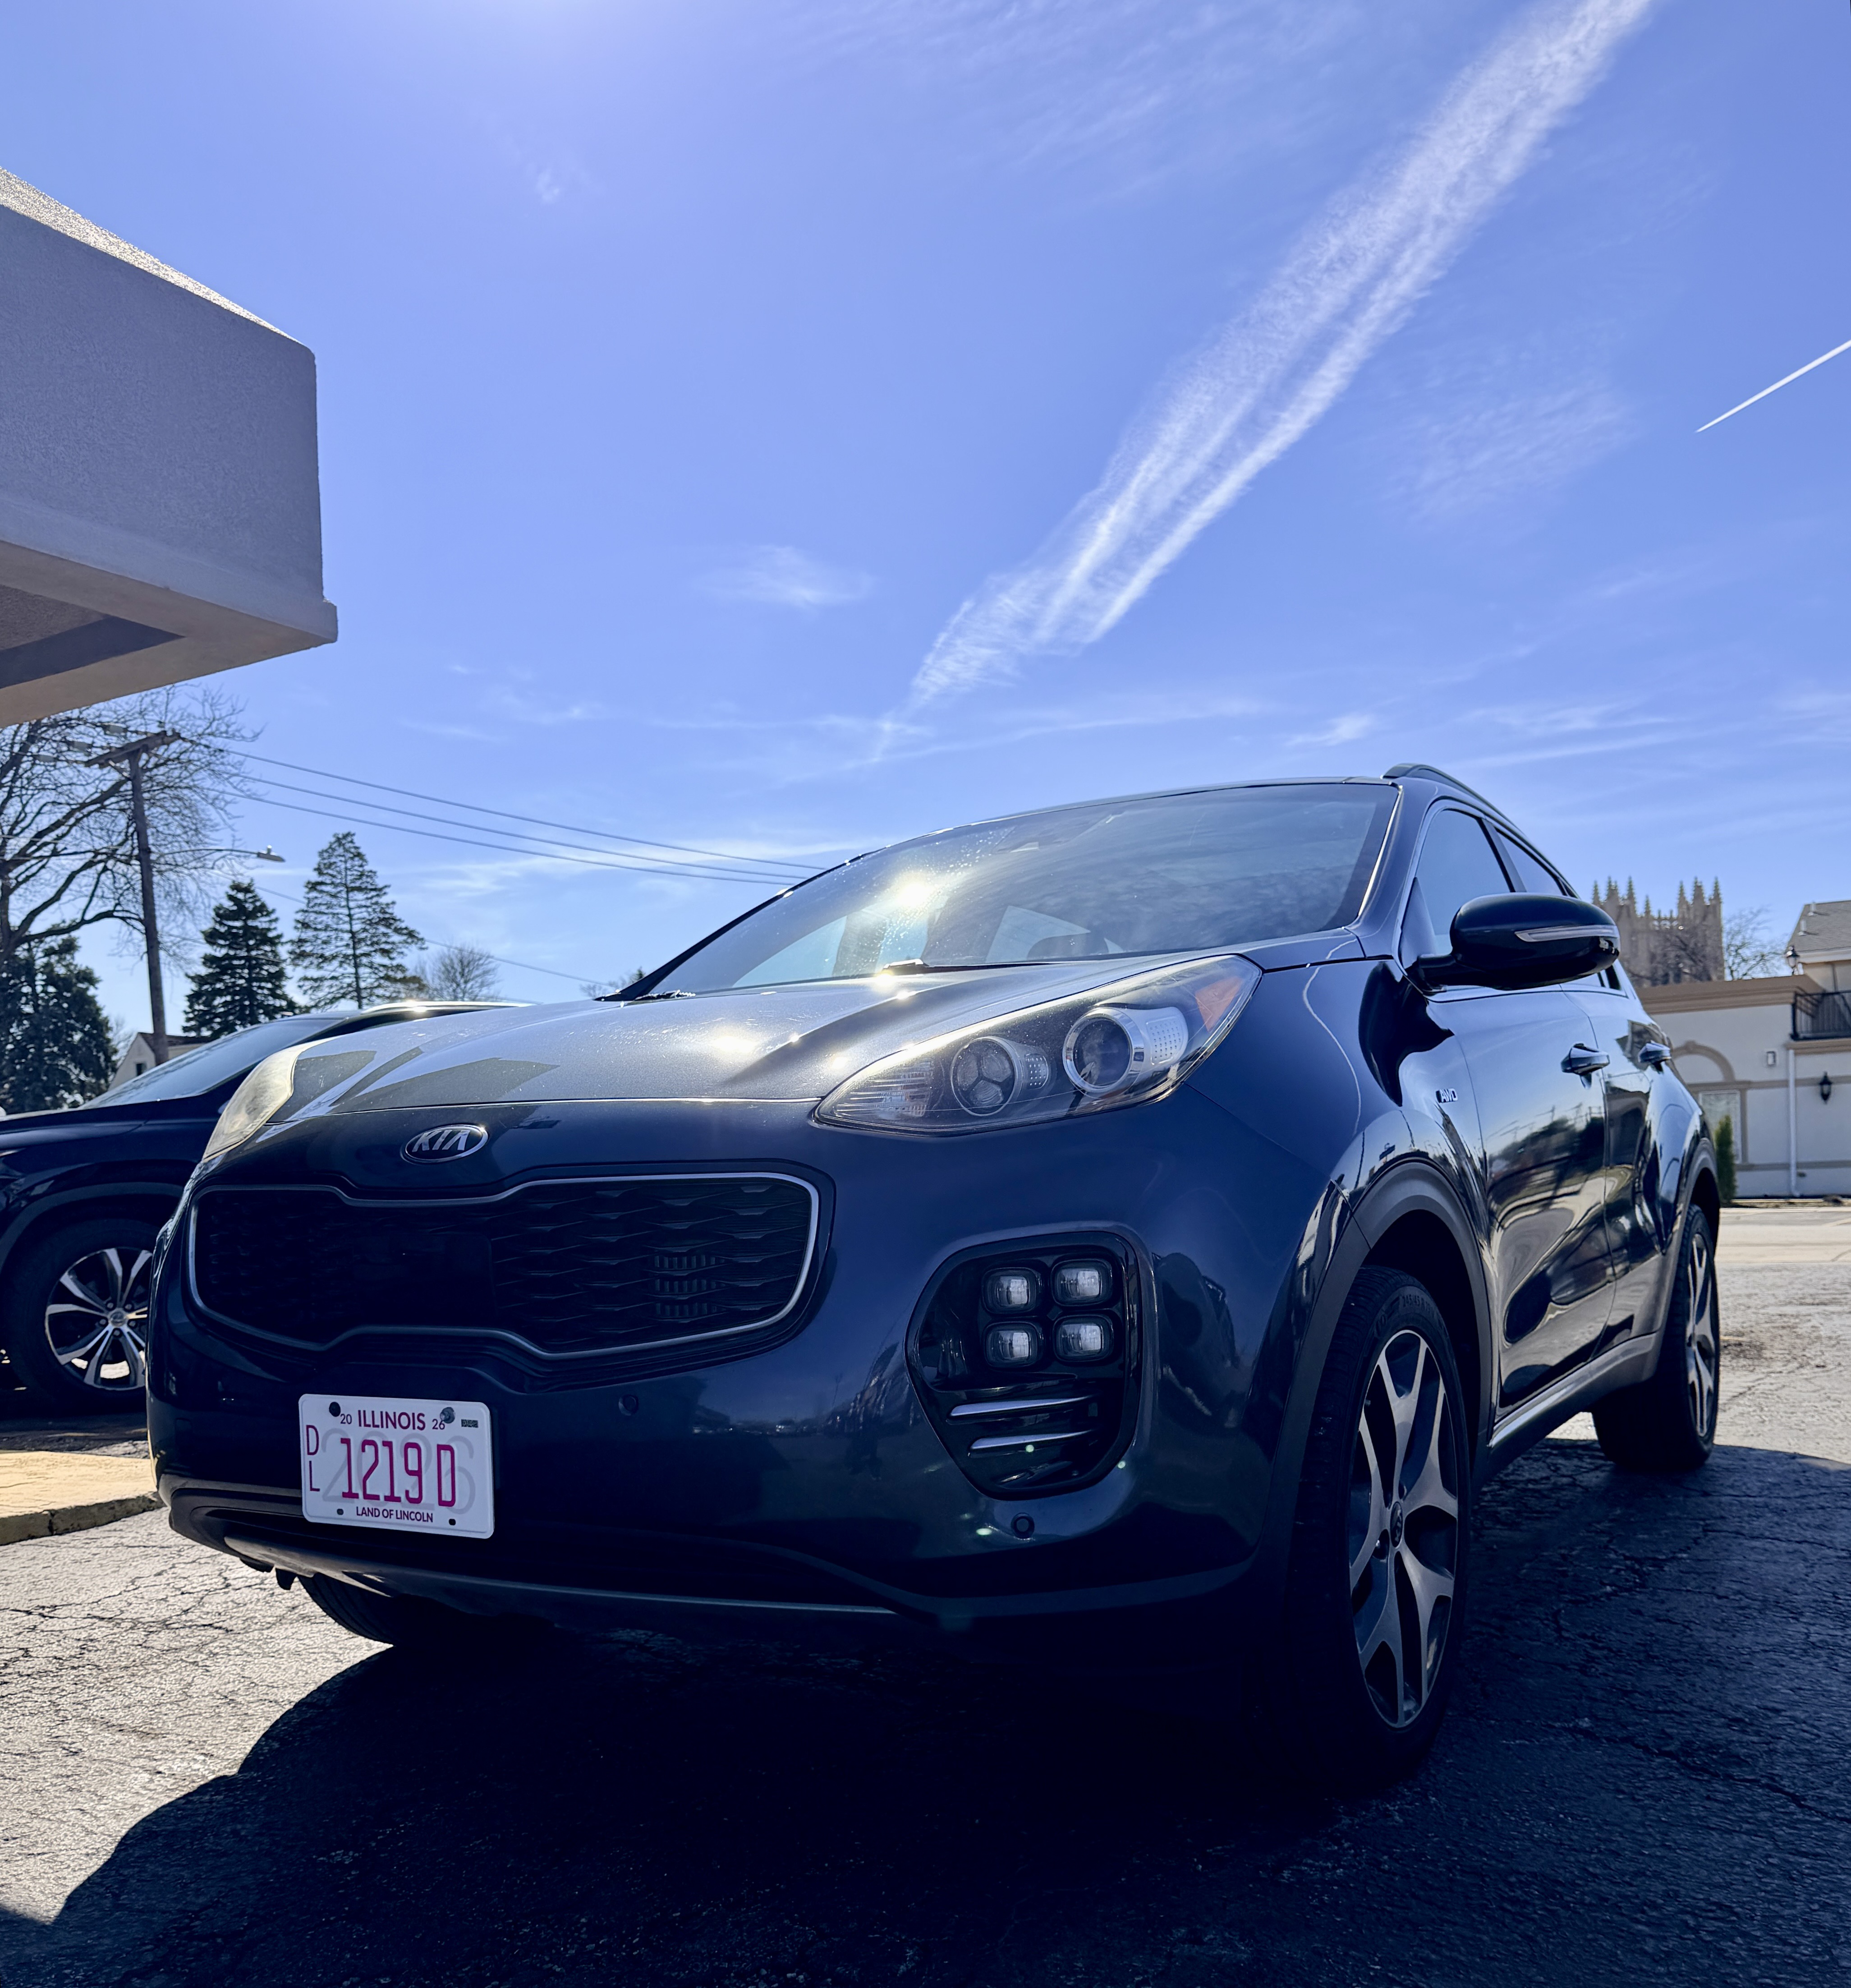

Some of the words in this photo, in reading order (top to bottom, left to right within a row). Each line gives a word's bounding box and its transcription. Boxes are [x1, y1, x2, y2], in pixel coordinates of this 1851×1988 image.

[1439, 1088, 1458, 1103] AWD
[411, 1129, 471, 1152] KIA
[340, 1413, 352, 1425] 20
[358, 1409, 426, 1431] ILLINOIS
[432, 1418, 446, 1430] 26
[355, 1506, 381, 1518] LAND
[381, 1508, 394, 1519] OF
[395, 1509, 433, 1523] LINCOLN
